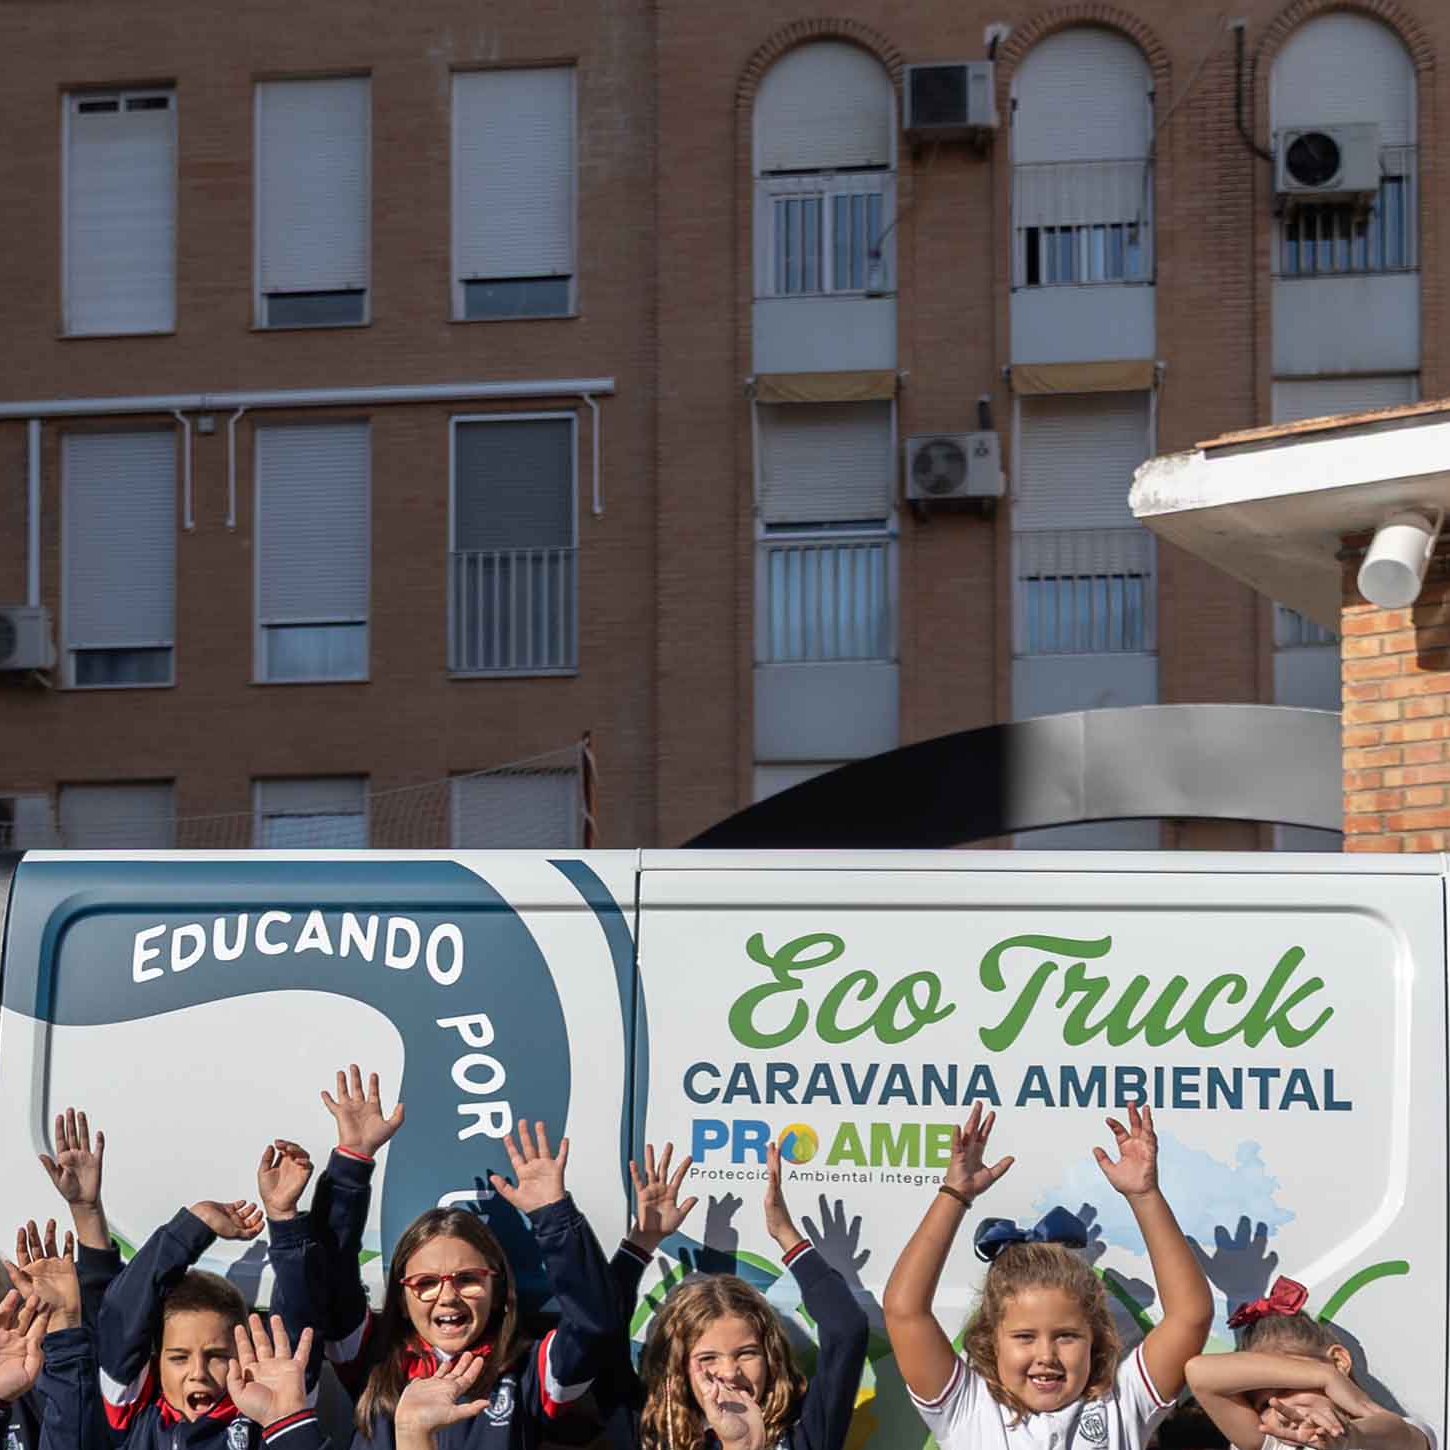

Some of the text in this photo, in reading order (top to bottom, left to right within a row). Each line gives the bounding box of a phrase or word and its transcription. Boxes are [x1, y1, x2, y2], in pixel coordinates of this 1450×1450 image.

[132, 910, 464, 985] EDUCANDO
[728, 932, 1335, 1052] Eco Truck
[436, 1012, 513, 1141] POR
[682, 1060, 1353, 1112] CARAVANA AMBIENTAL
[788, 1169, 873, 1184] Ambiental
